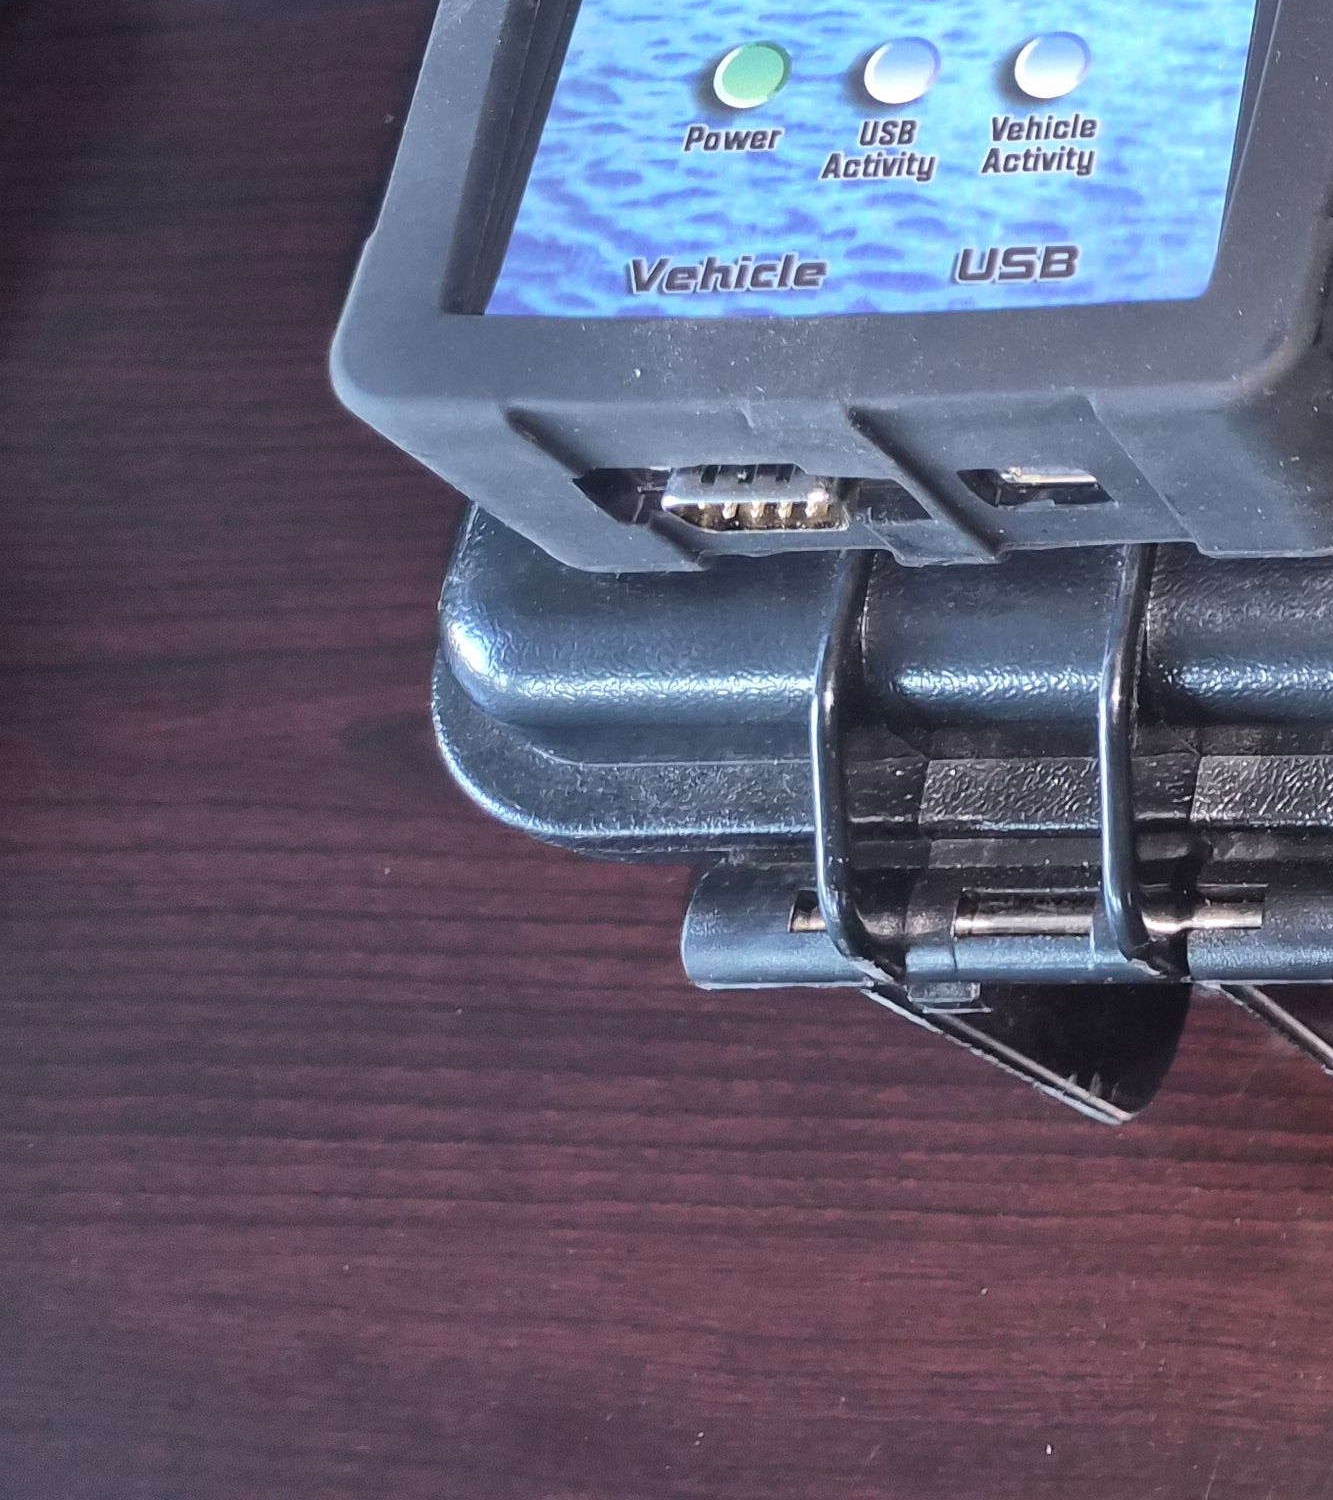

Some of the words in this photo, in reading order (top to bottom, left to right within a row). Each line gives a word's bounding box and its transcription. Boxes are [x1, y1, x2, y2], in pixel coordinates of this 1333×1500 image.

[683, 125, 783, 151] Power
[858, 120, 918, 145] USB
[991, 114, 1097, 142] Vehicle
[820, 152, 936, 182] Activity
[981, 147, 1095, 176] Activity
[630, 255, 827, 293] Vehicle
[956, 246, 1079, 282] USB
